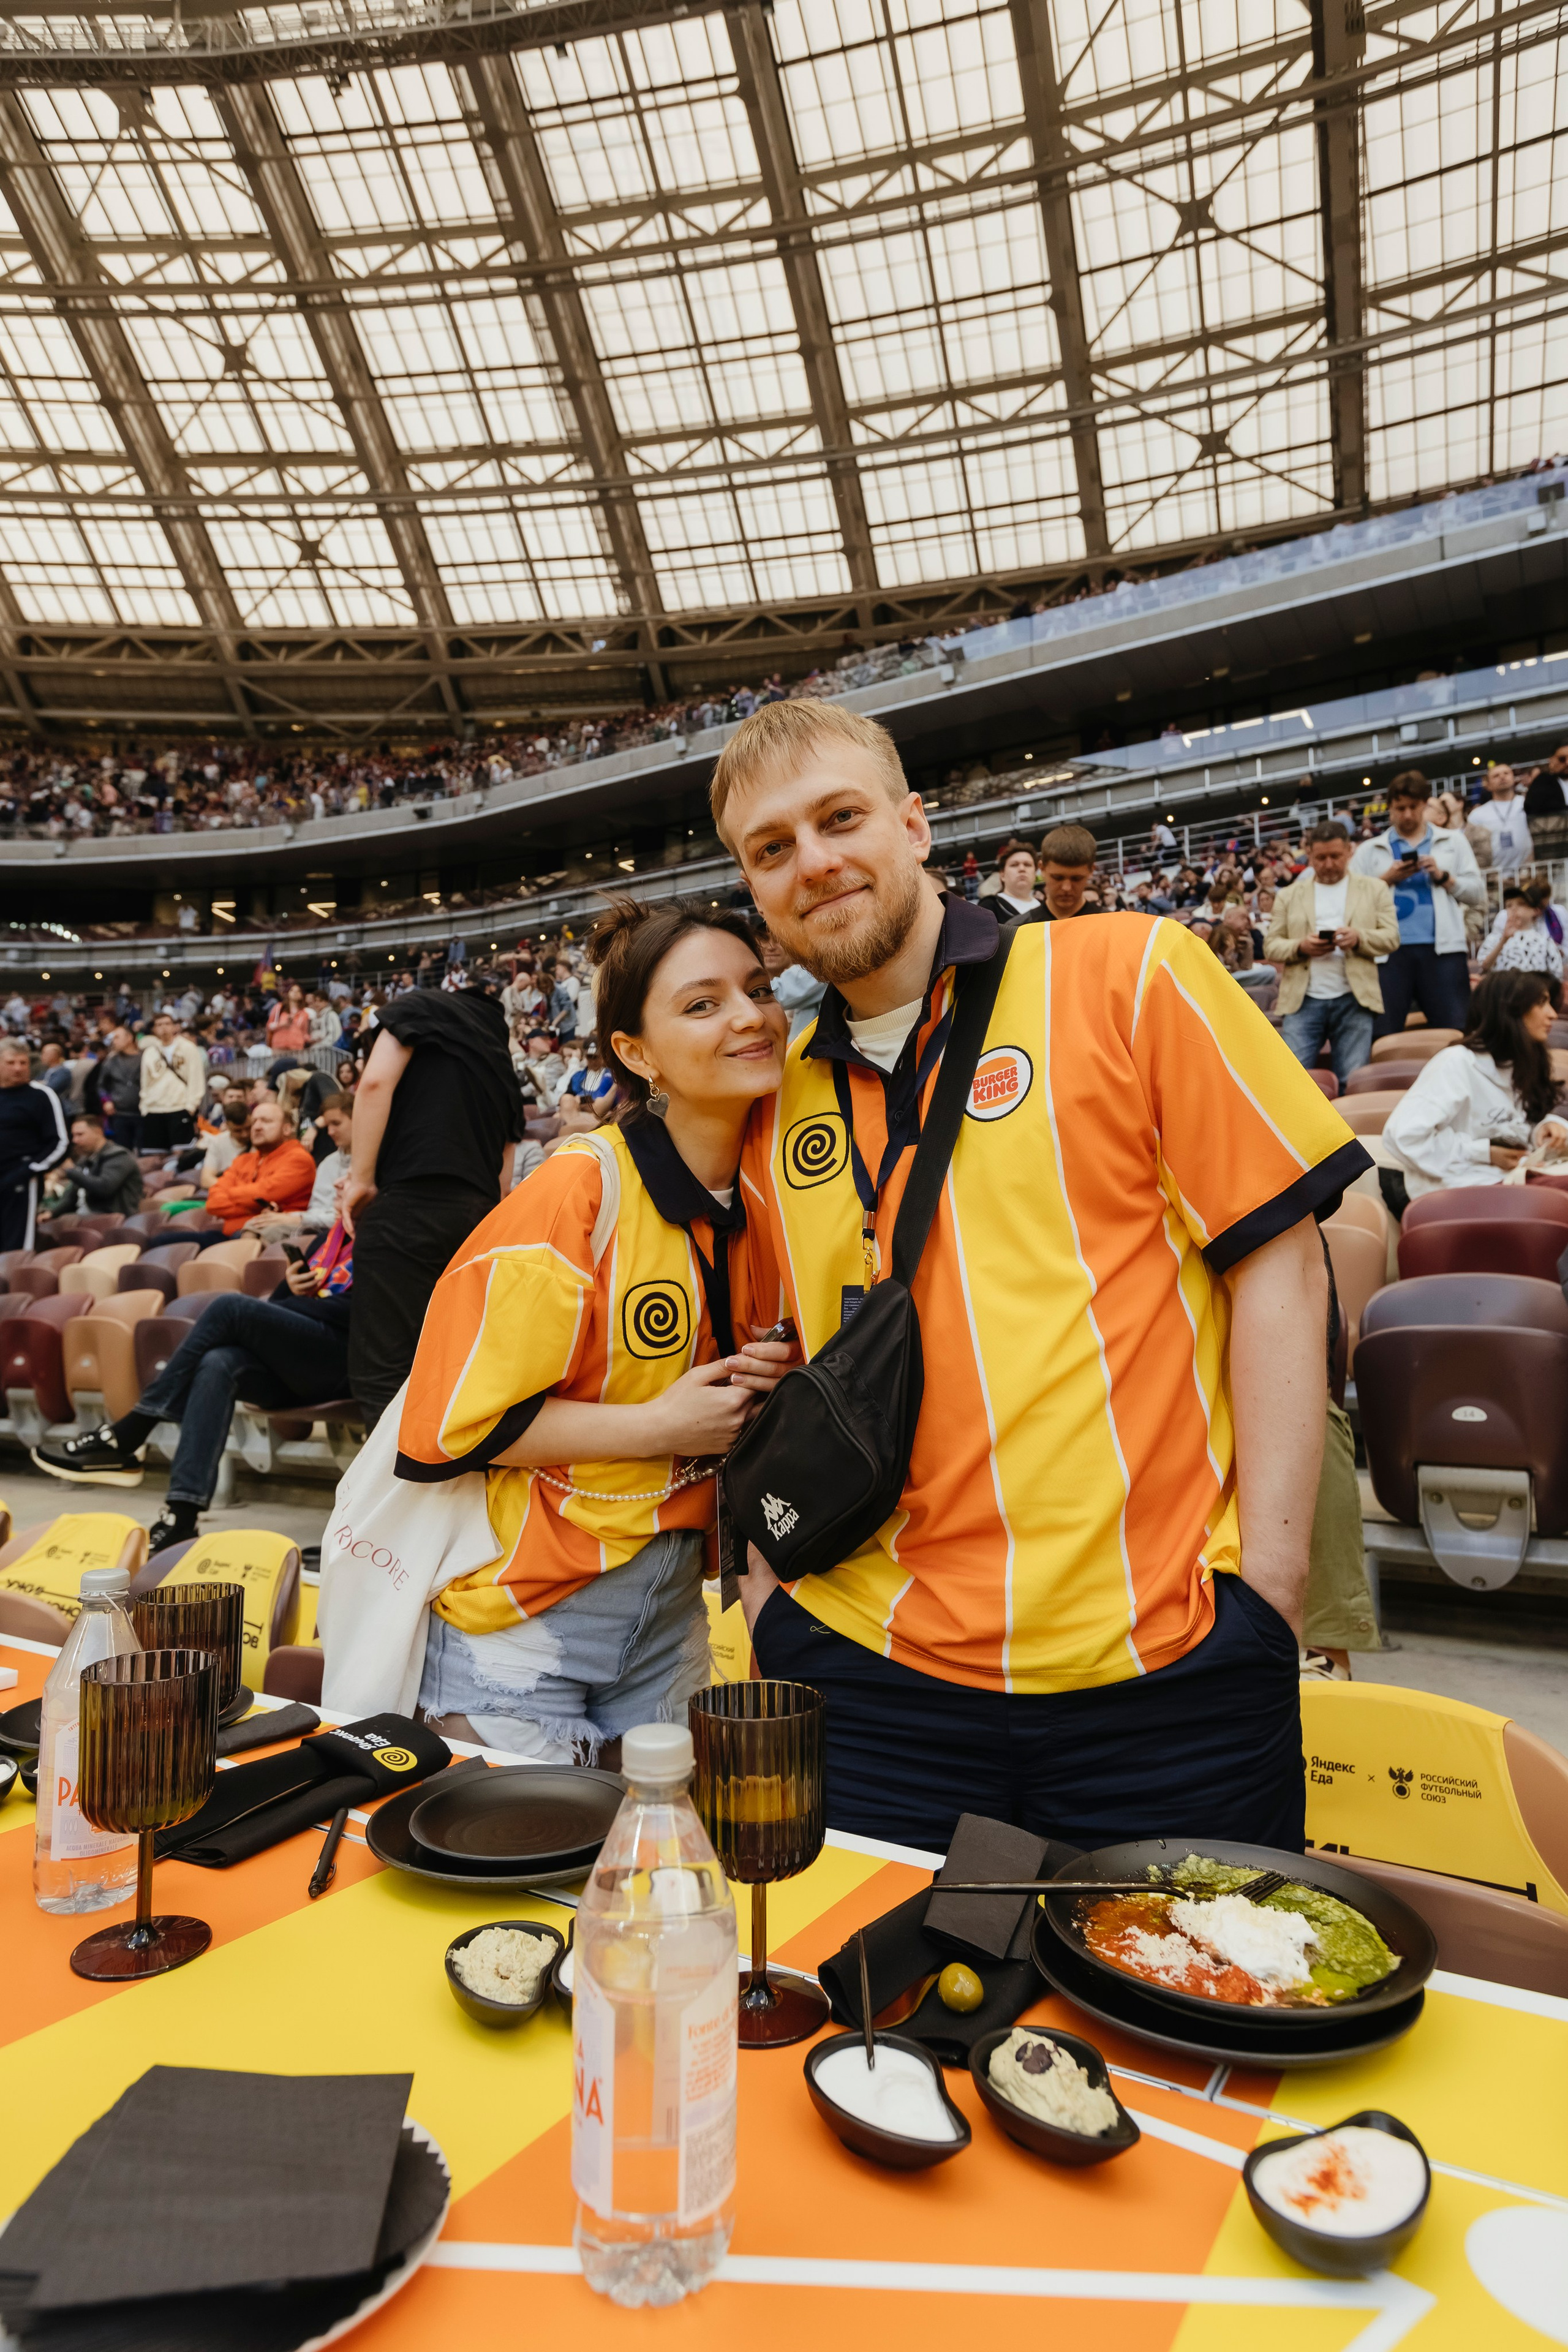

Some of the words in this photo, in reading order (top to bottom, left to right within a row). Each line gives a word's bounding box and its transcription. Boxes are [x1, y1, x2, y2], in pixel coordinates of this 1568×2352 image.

[973, 1066, 1018, 1090] BURGER
[973, 1077, 1019, 1104] KING
[770, 1508, 799, 1541] Kappa
[330, 1729, 377, 1750] Яндекс
[364, 1733, 391, 1747] Еда
[1311, 1756, 1355, 1774] Яндекс
[1311, 1770, 1333, 1785] Еда
[1420, 1773, 1478, 1789] РОССИЙСКИЙ
[1420, 1782, 1482, 1800] ФУТБОЛЬНЫЙ
[1421, 1792, 1446, 1804] СОЮЗ
[83, 1840, 108, 1850] MINERALE
[108, 1834, 129, 1845] NATURALE
[79, 1846, 118, 1856] OLIGOMINERALE
